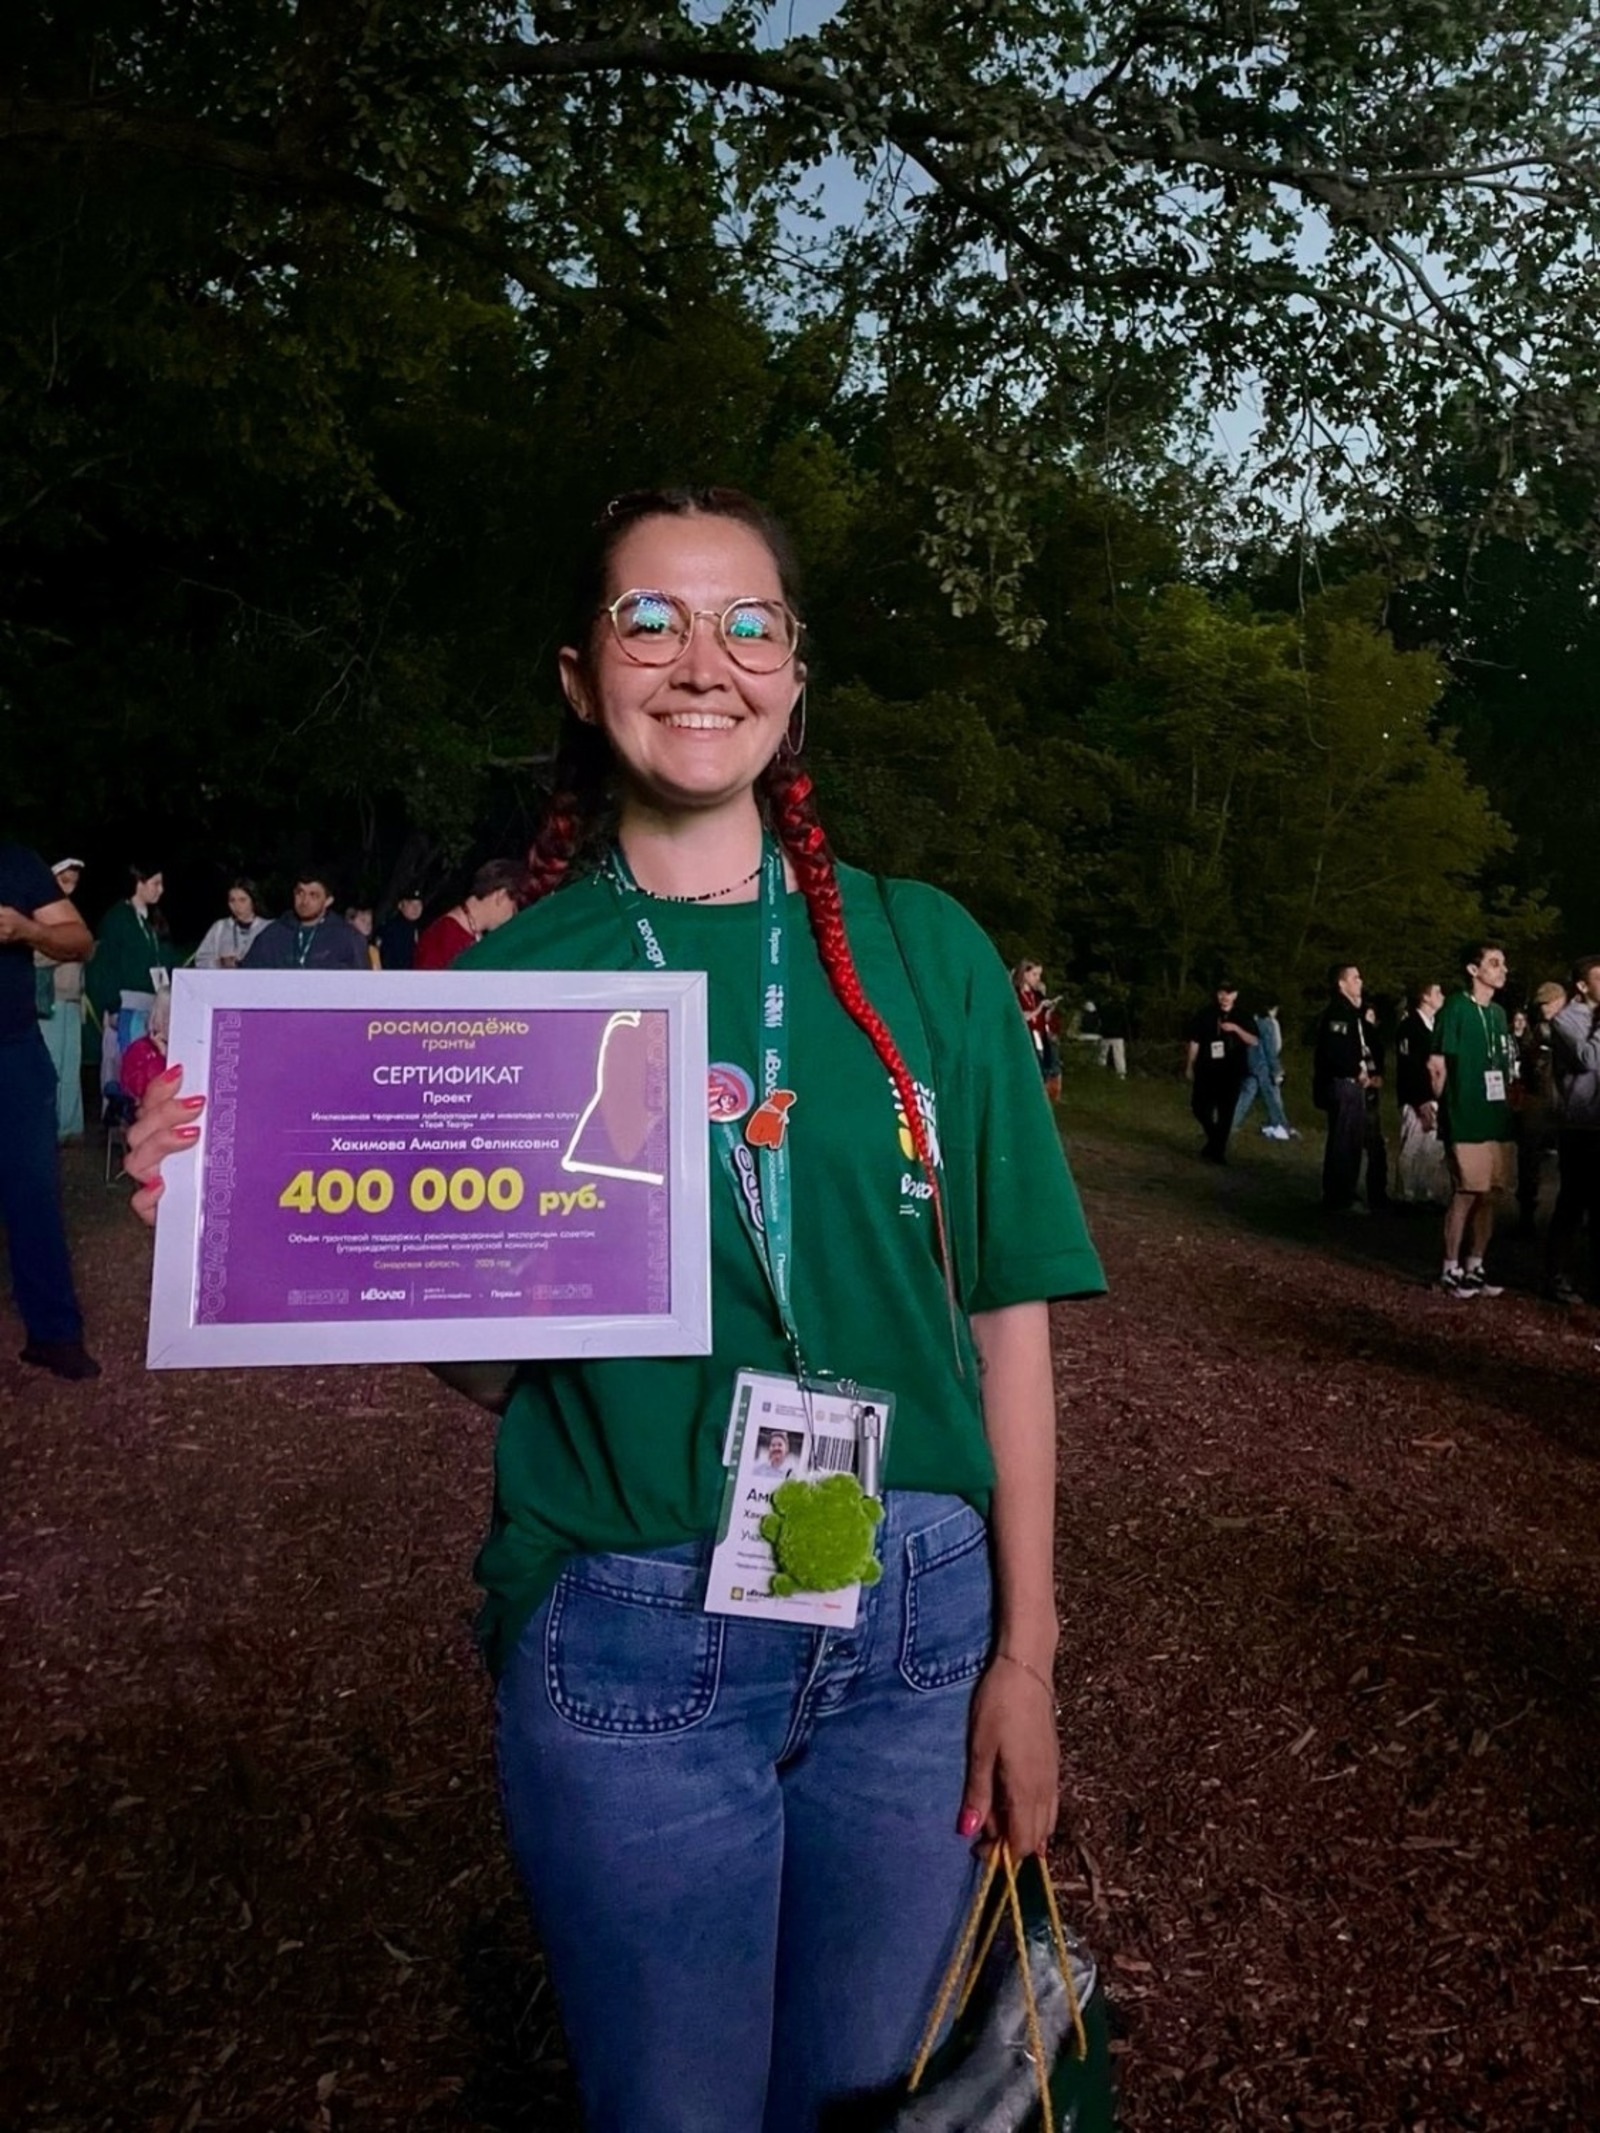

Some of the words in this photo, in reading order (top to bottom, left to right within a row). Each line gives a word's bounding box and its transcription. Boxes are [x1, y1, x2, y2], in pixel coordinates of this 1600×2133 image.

[768, 927, 782, 965] Первые
[368, 1018, 529, 1040] росмолодёжь
[422, 1039, 476, 1052] гранты
[373, 1066, 523, 1085] СЕРТИФИКАТ
[422, 1091, 472, 1104] Проект
[372, 1113, 420, 1122] творческая
[421, 1111, 479, 1121] лаборатория
[480, 1112, 495, 1120] для
[331, 1137, 406, 1151] Хакимова
[409, 1137, 467, 1151] Амалия
[470, 1136, 560, 1150] Феликсовна
[279, 1168, 394, 1213] 400
[410, 1167, 525, 1212] 000
[539, 1183, 606, 1216] руб.
[322, 1233, 369, 1243] грантовой
[424, 1231, 505, 1242] рекомендованный
[507, 1231, 558, 1241] экспертным
[451, 1242, 502, 1252] конкурсной
[361, 1288, 406, 1301] иВолга
